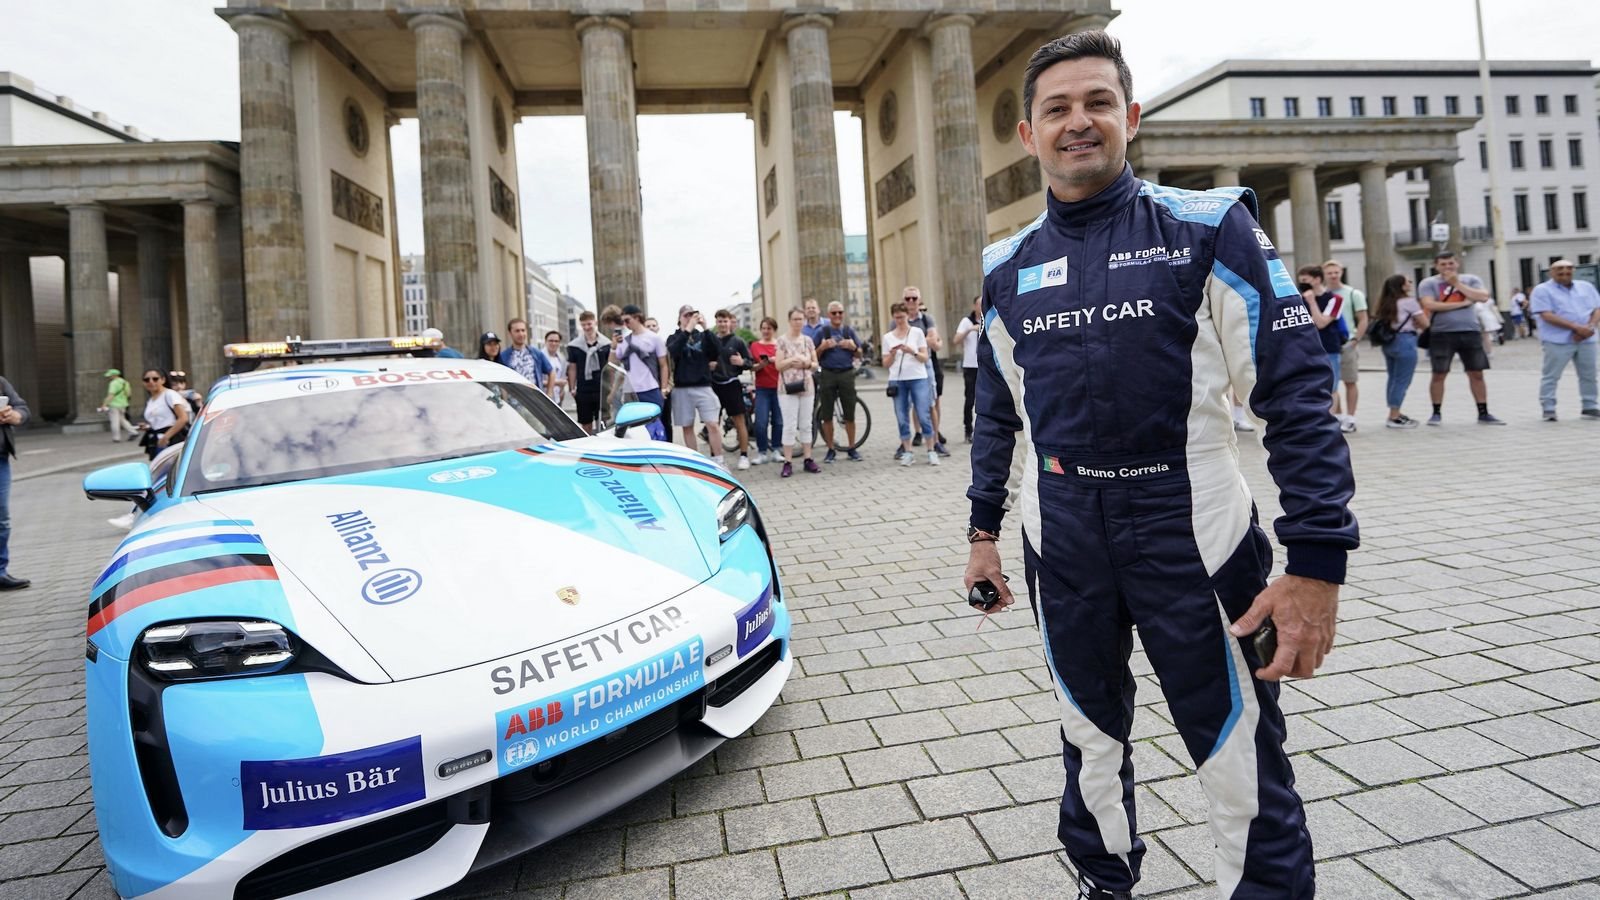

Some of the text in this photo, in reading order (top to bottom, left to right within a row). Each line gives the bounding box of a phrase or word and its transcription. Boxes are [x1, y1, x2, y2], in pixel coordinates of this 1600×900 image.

[1181, 201, 1221, 212] OMP
[1108, 252, 1132, 262] ABB
[1022, 299, 1156, 335] SAFETY CAR
[351, 369, 474, 388] BOSCH
[1076, 463, 1170, 478] Bruno Correia
[600, 480, 666, 531] Allianz
[326, 510, 391, 571] Allianz
[744, 607, 769, 641] Julius
[490, 606, 690, 696] SAFETY CAR
[505, 640, 700, 741] ABB FORMULA E
[545, 718, 600, 749] WORLD
[605, 670, 700, 725] CHAMPIONSHIP
[260, 766, 401, 810] Julius Bär
